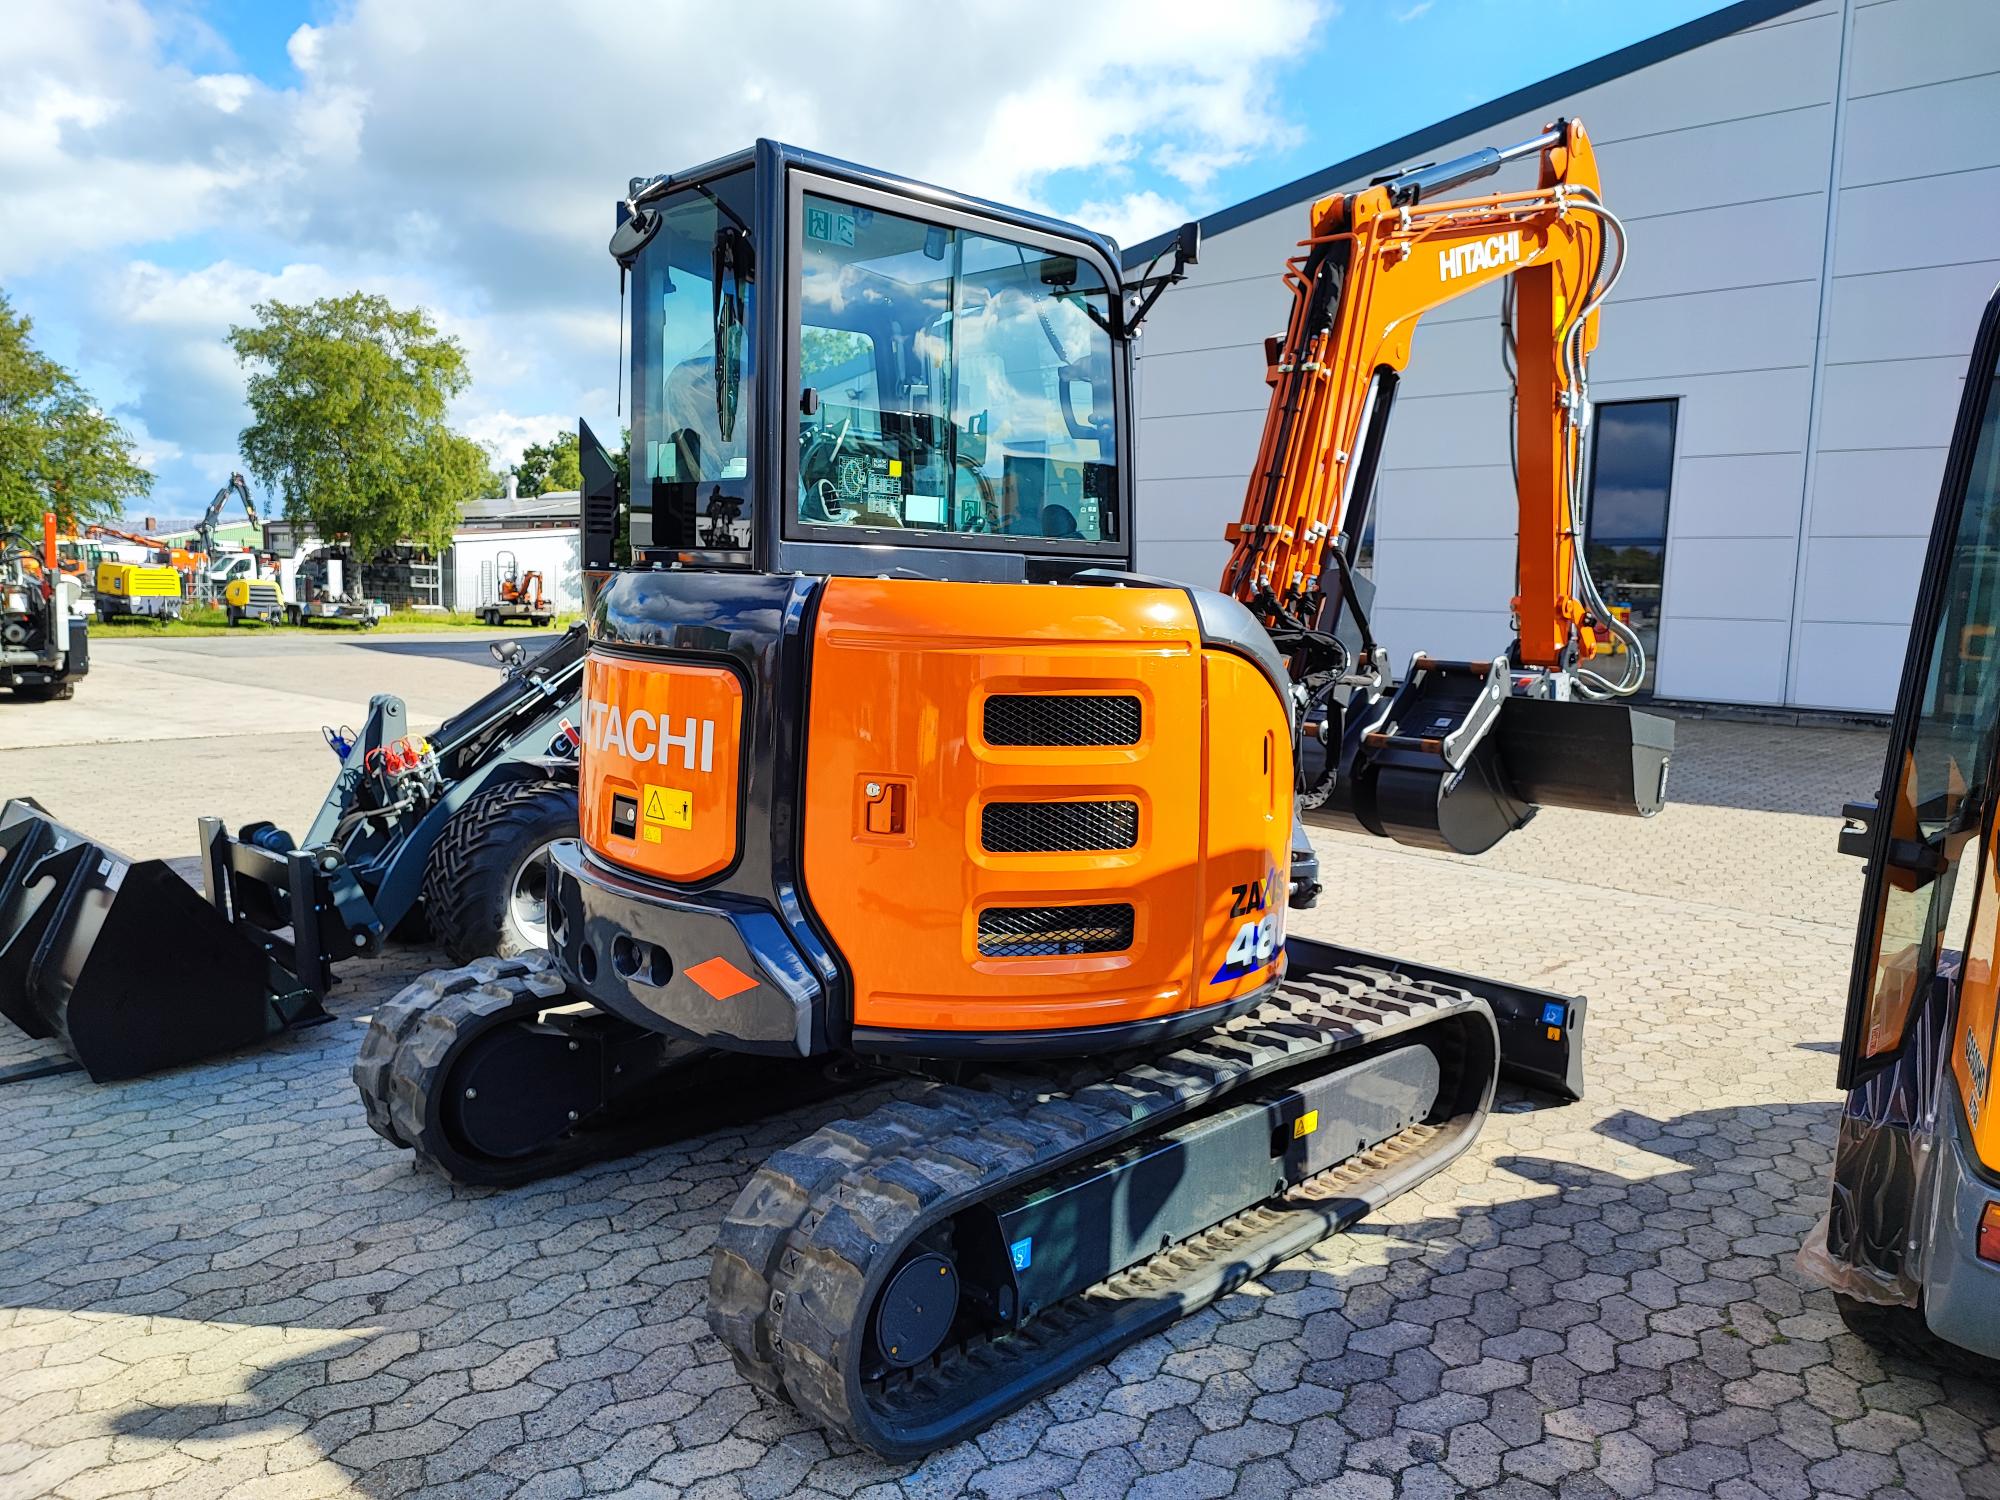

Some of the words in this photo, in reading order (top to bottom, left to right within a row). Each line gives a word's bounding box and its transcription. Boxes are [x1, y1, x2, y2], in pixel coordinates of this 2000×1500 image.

[1438, 230, 1521, 282] HITACHI
[582, 698, 715, 773] ITACHI
[1229, 867, 1285, 919] ZAXIS
